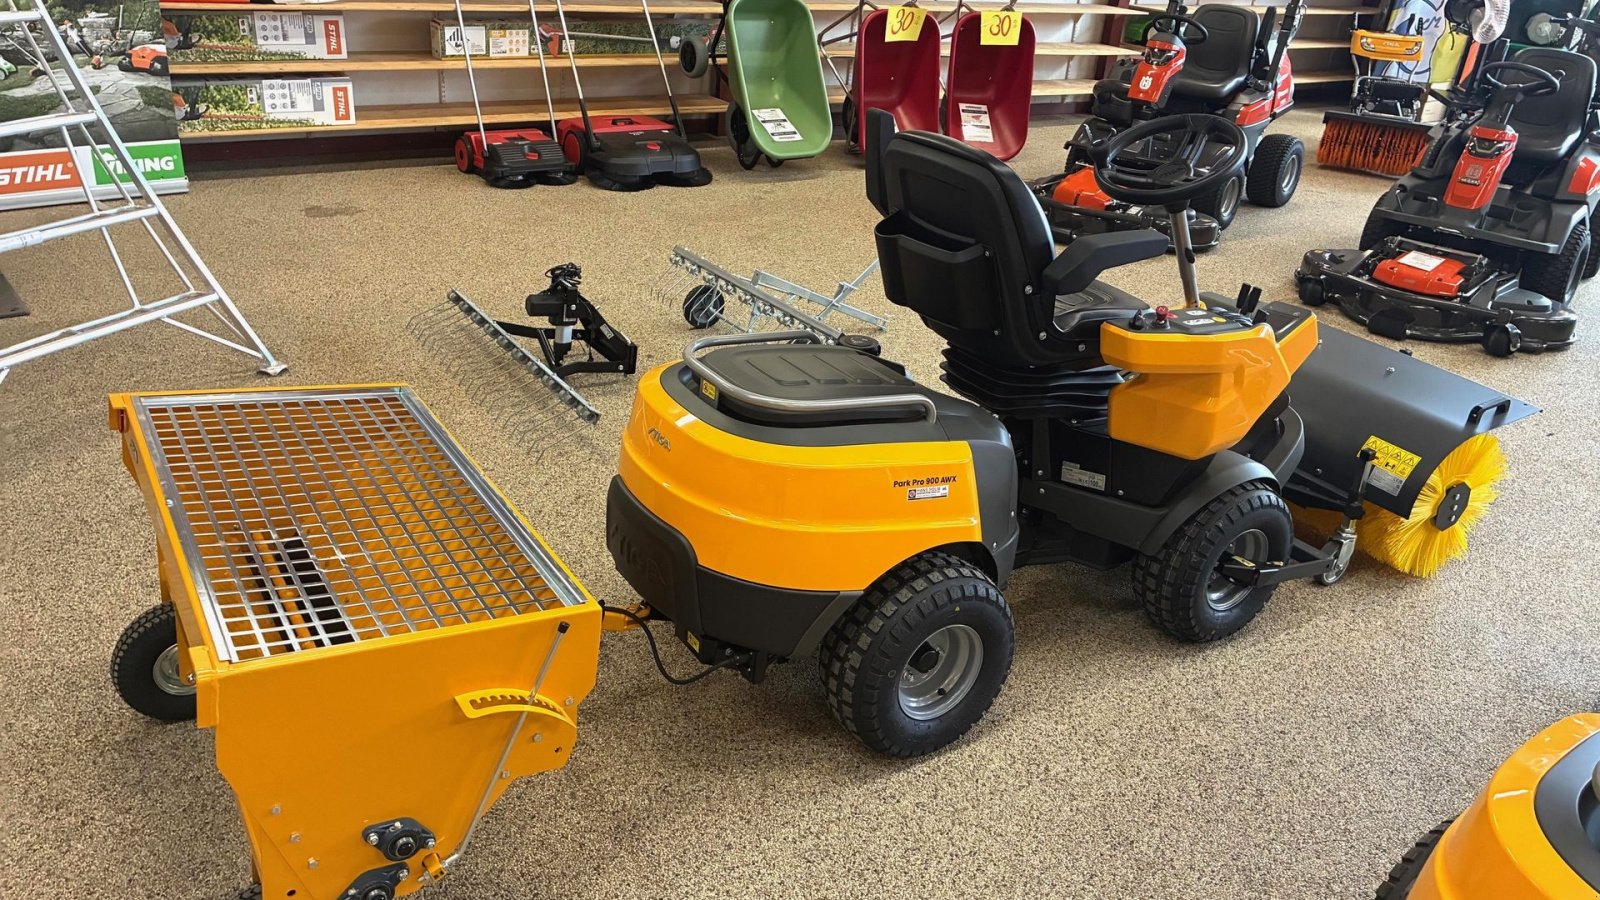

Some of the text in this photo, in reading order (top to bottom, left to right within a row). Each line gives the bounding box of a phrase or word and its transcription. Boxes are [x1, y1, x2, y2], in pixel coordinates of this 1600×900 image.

[328, 24, 338, 51] STIHL
[336, 90, 346, 117] STIHL
[103, 157, 175, 175] VIING
[893, 475, 956, 488] Park Pro 900 AWX
